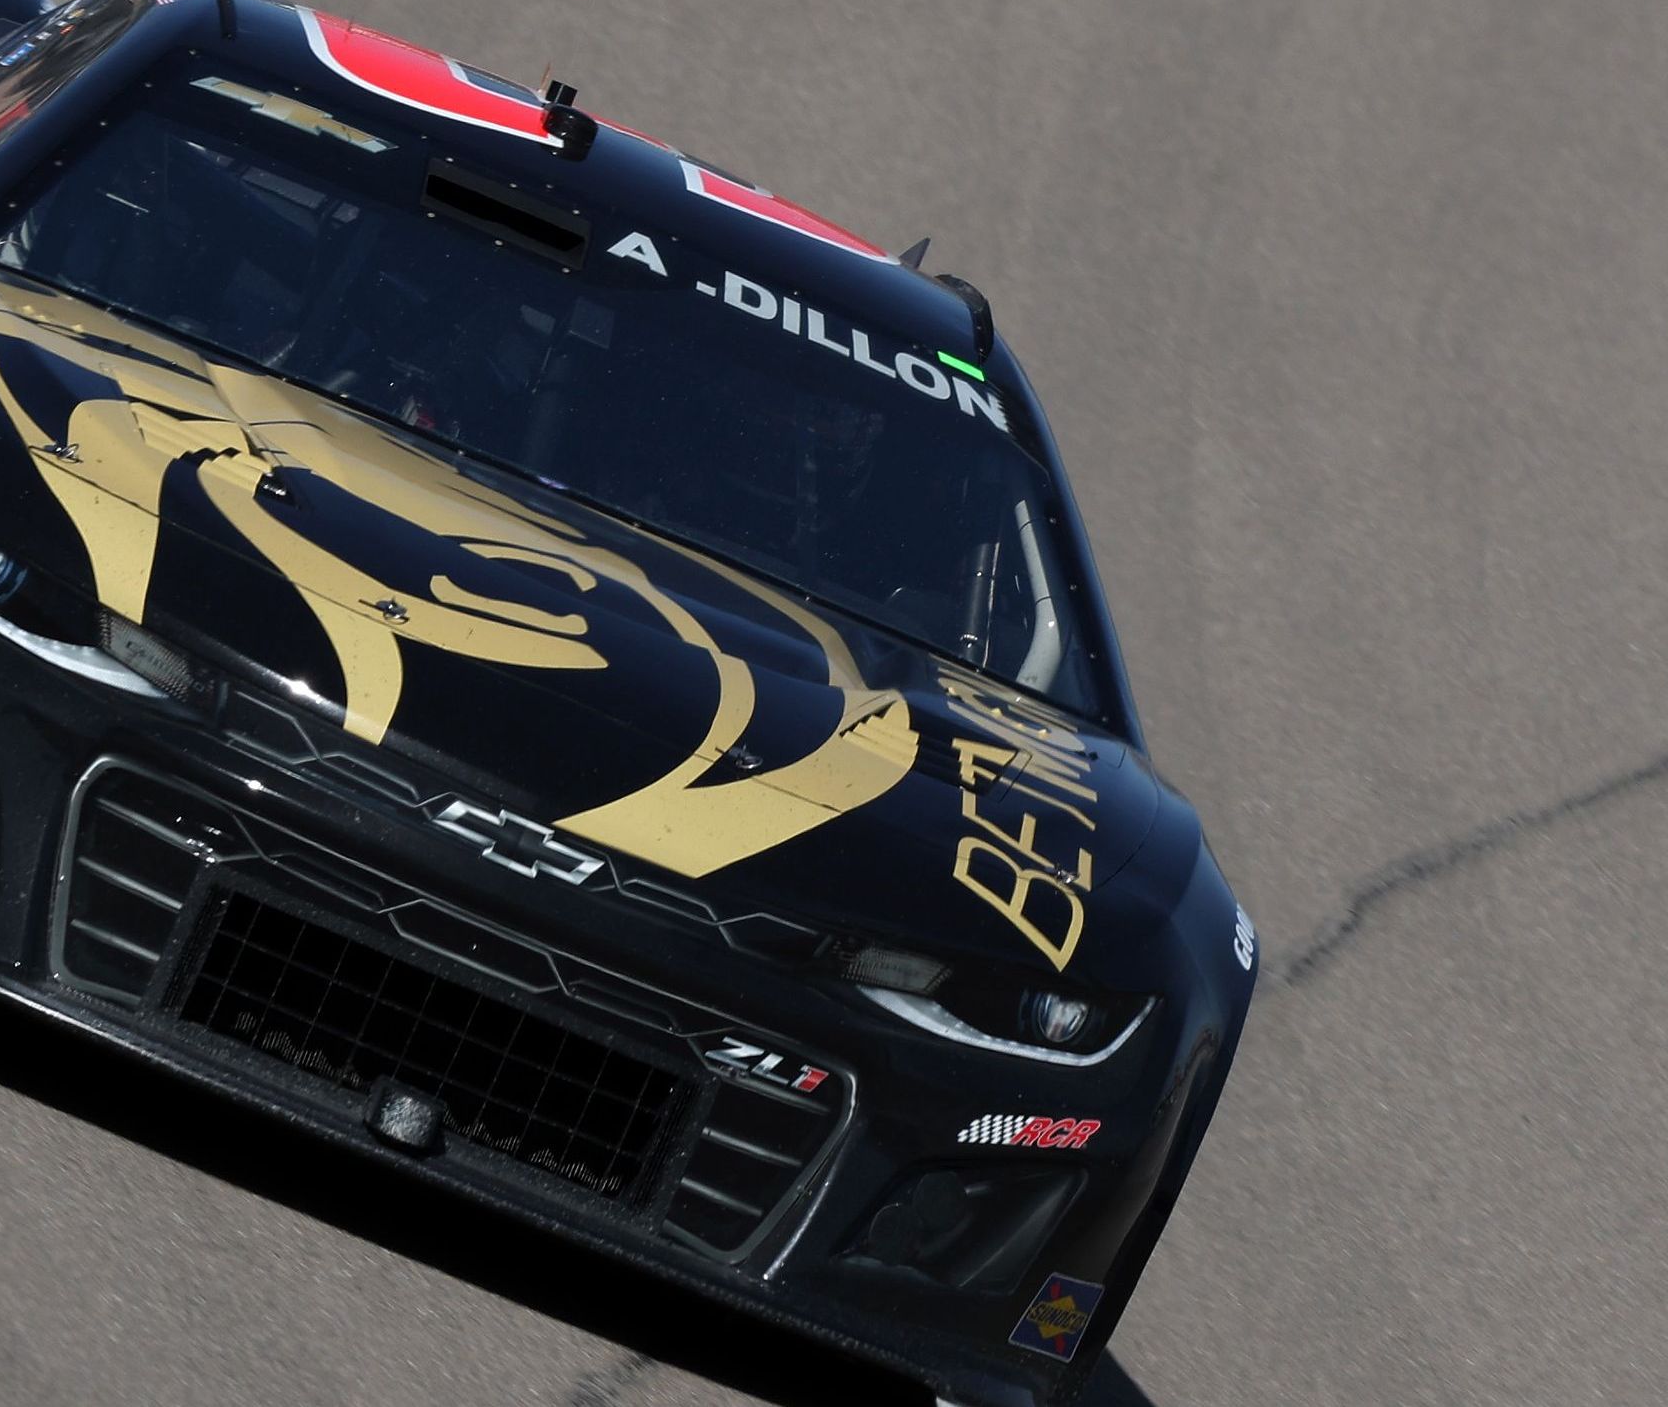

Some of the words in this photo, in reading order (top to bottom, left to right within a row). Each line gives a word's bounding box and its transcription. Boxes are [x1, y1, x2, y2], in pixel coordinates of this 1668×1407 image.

[705, 1036, 830, 1092] ZL1
[1011, 1116, 1101, 1149] RCR
[1031, 1301, 1089, 1335] SUNOCO
